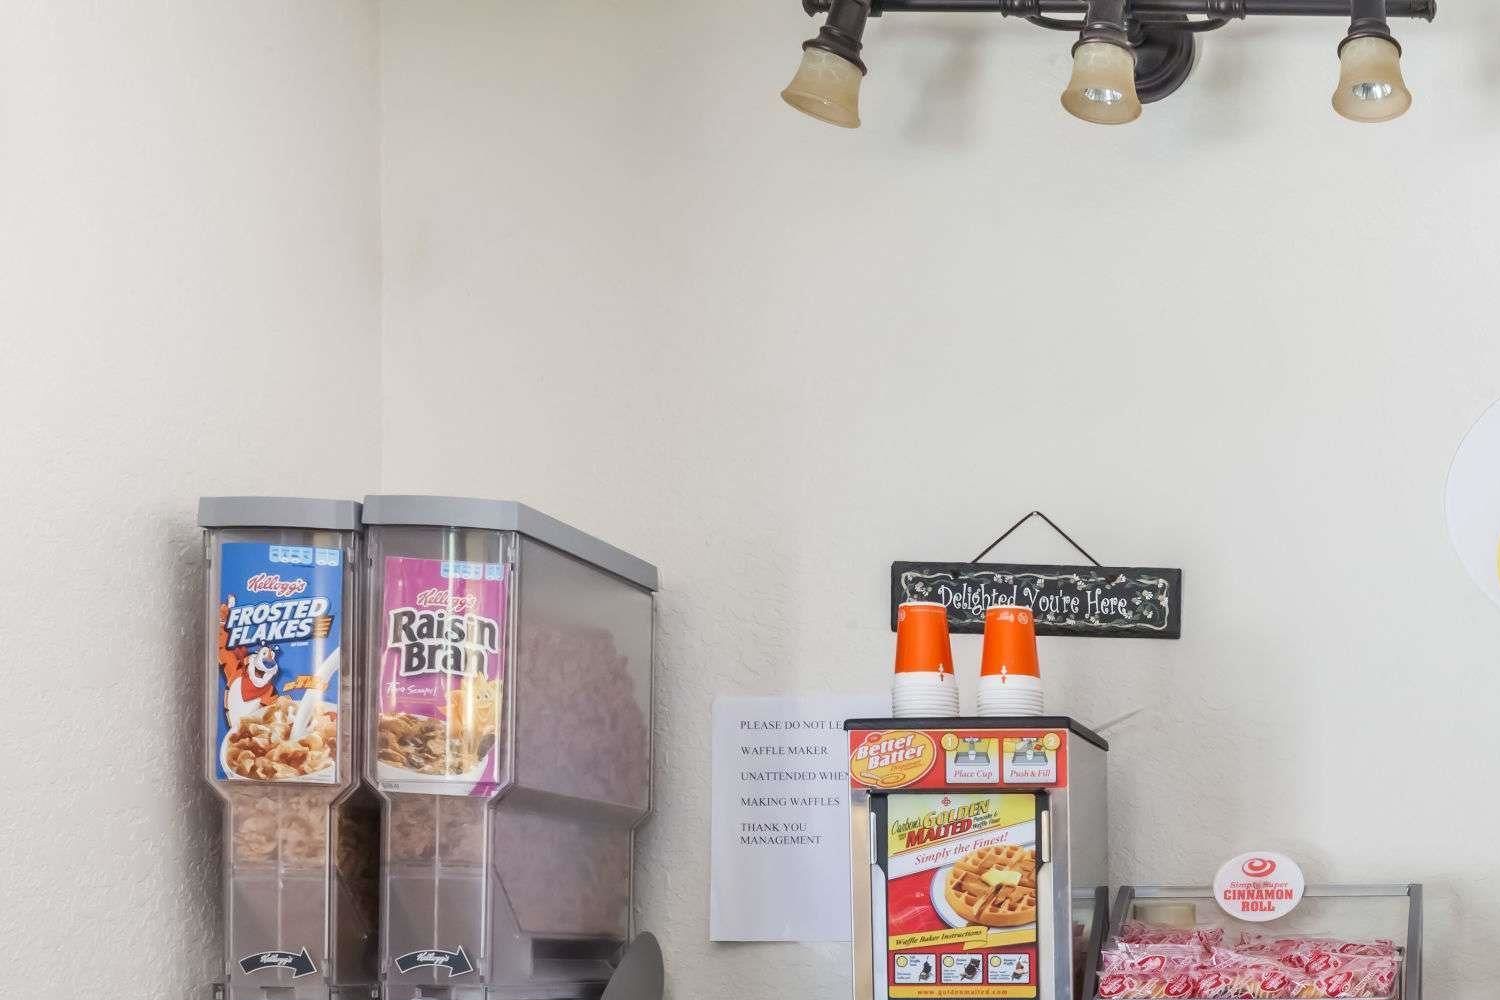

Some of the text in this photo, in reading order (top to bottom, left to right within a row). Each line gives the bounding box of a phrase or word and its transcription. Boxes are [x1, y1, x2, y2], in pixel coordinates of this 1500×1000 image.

[247, 573, 307, 597] Kellogg's
[938, 583, 1128, 615] Delighted You're Here
[227, 597, 330, 629] FROSTED
[227, 618, 314, 648] FLAKES
[389, 607, 498, 652] Raisin
[400, 641, 487, 677] Bran
[740, 720, 781, 730] PLEASE
[784, 720, 801, 730] DO
[803, 720, 825, 730] NOT
[741, 746, 829, 756] WAFFLE MAKER
[857, 734, 915, 759] Better
[868, 744, 925, 770] Batter
[741, 771, 816, 781] UNATTENDED
[741, 797, 841, 807] MAKING WAFFLES
[922, 799, 991, 829] GOLDEN
[741, 822, 807, 832] THANK YOU
[905, 818, 973, 848] MALTED
[740, 835, 821, 845] MANAGEMENT
[914, 831, 1009, 866] Simply the Finest!
[1223, 889, 1294, 900] CINNAMON
[1241, 901, 1275, 912] ROLL
